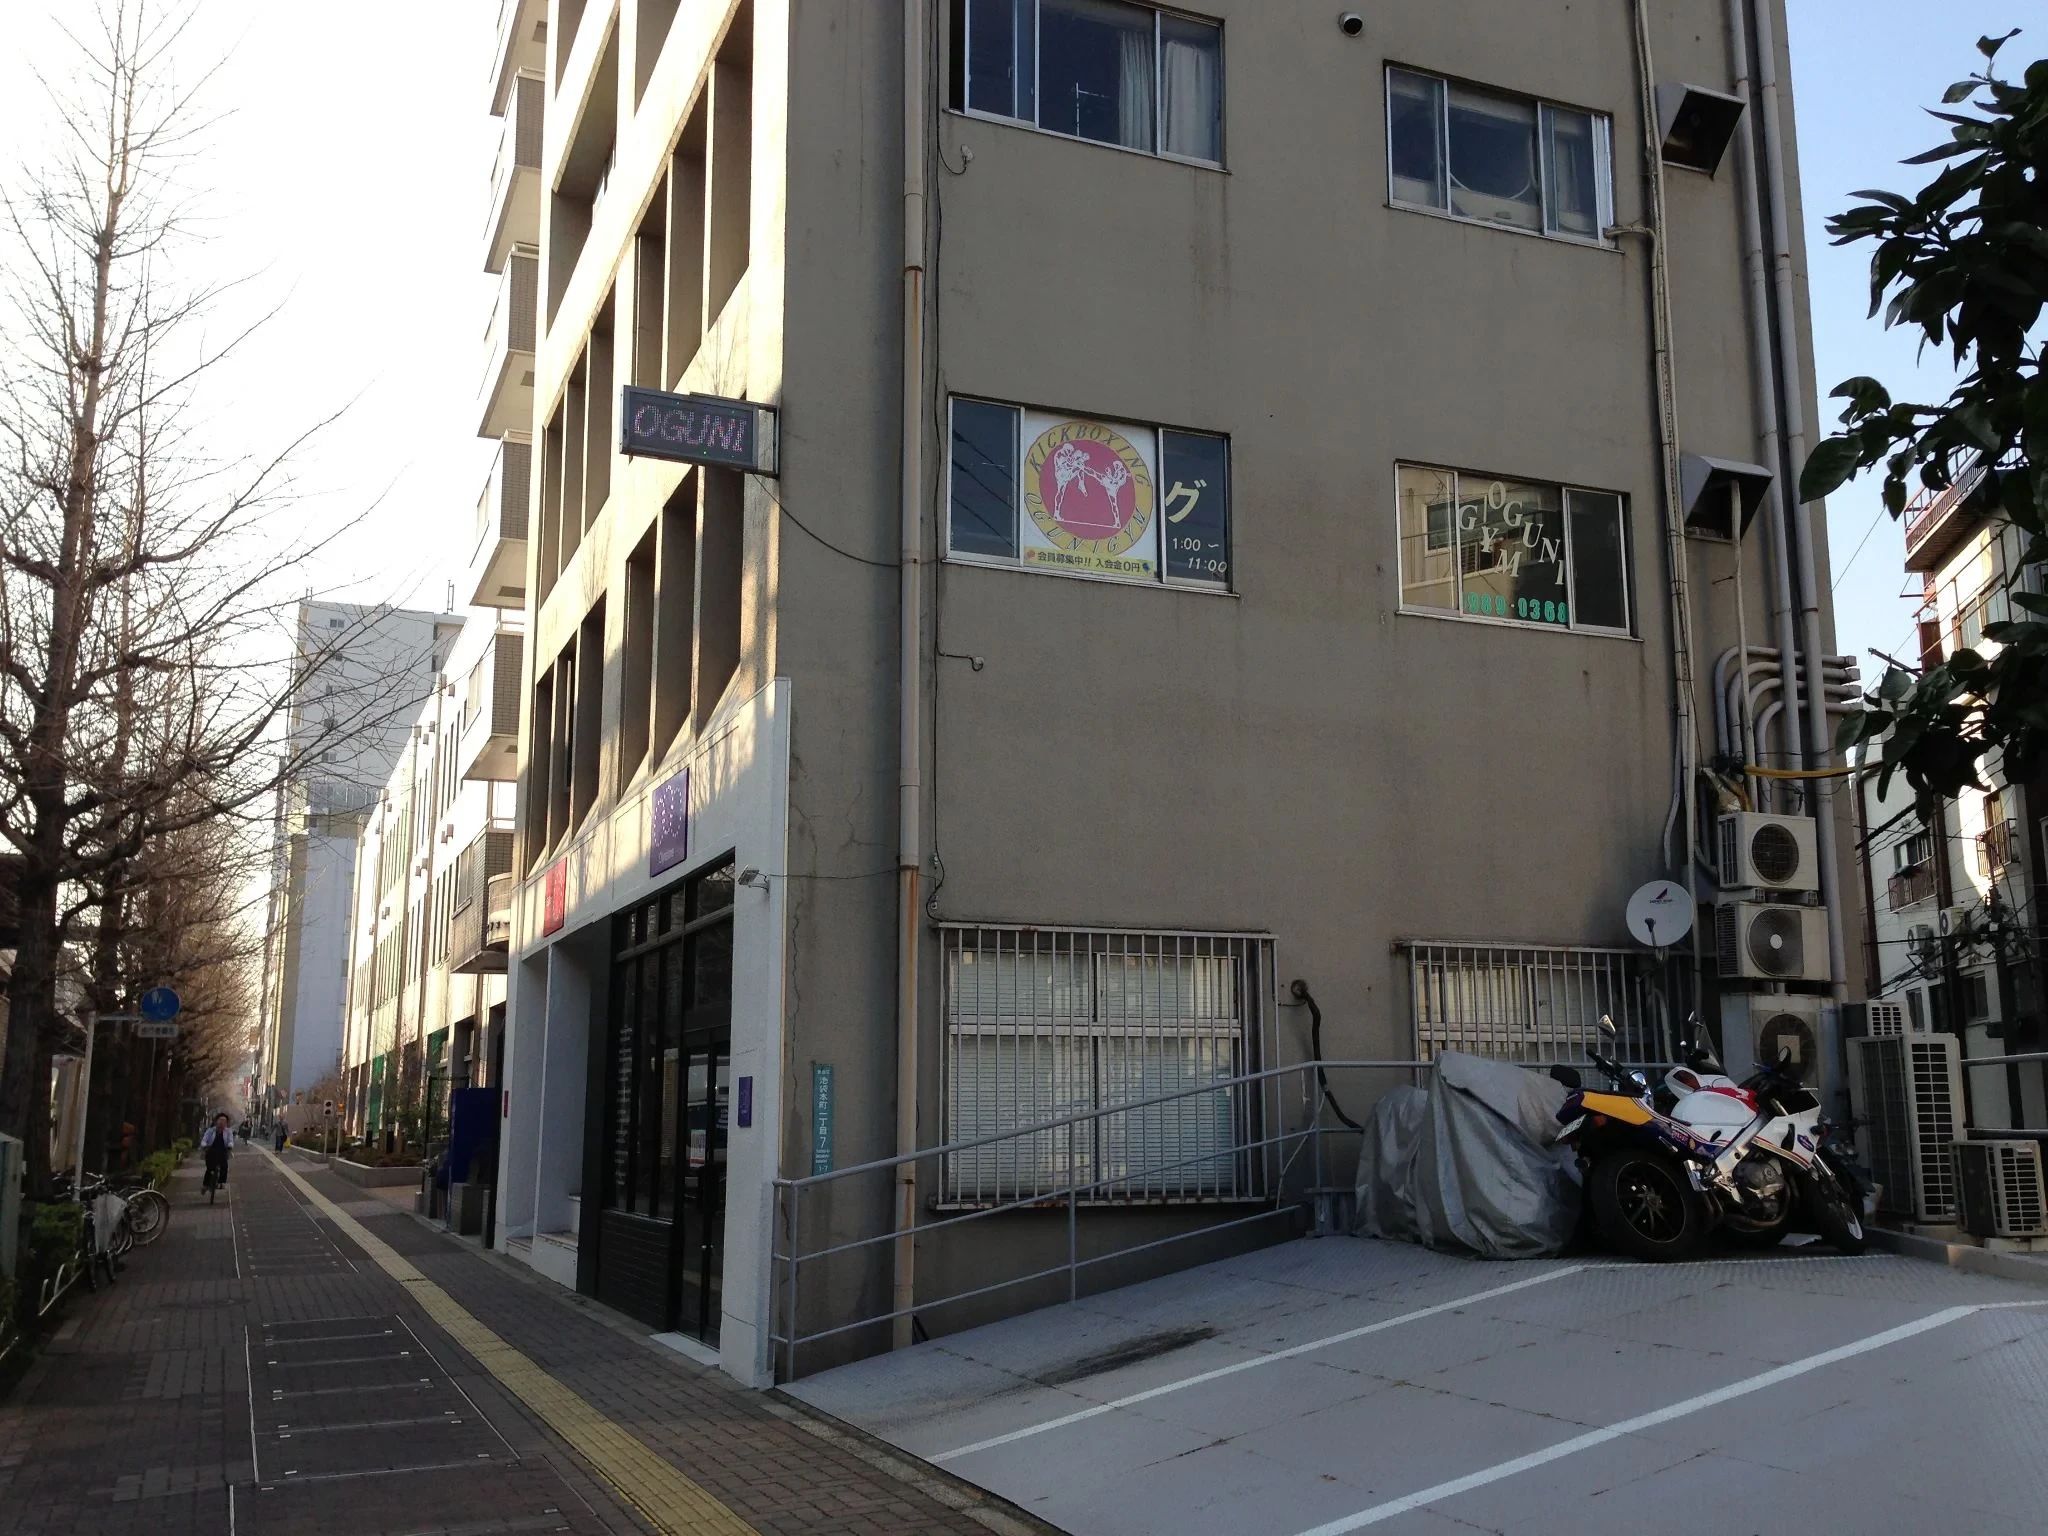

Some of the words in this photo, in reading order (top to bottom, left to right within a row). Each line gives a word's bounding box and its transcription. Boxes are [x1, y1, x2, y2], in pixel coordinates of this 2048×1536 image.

[634, 405, 747, 453] OGUNI
[1029, 423, 1152, 488] KICKBOXING
[1025, 492, 1100, 555] OGUNI
[1107, 510, 1148, 553] GYM
[1165, 479, 1207, 524] グ
[1188, 556, 1228, 573] 11:00
[1459, 504, 1522, 578] GYM
[1488, 481, 1565, 586] OGUNI
